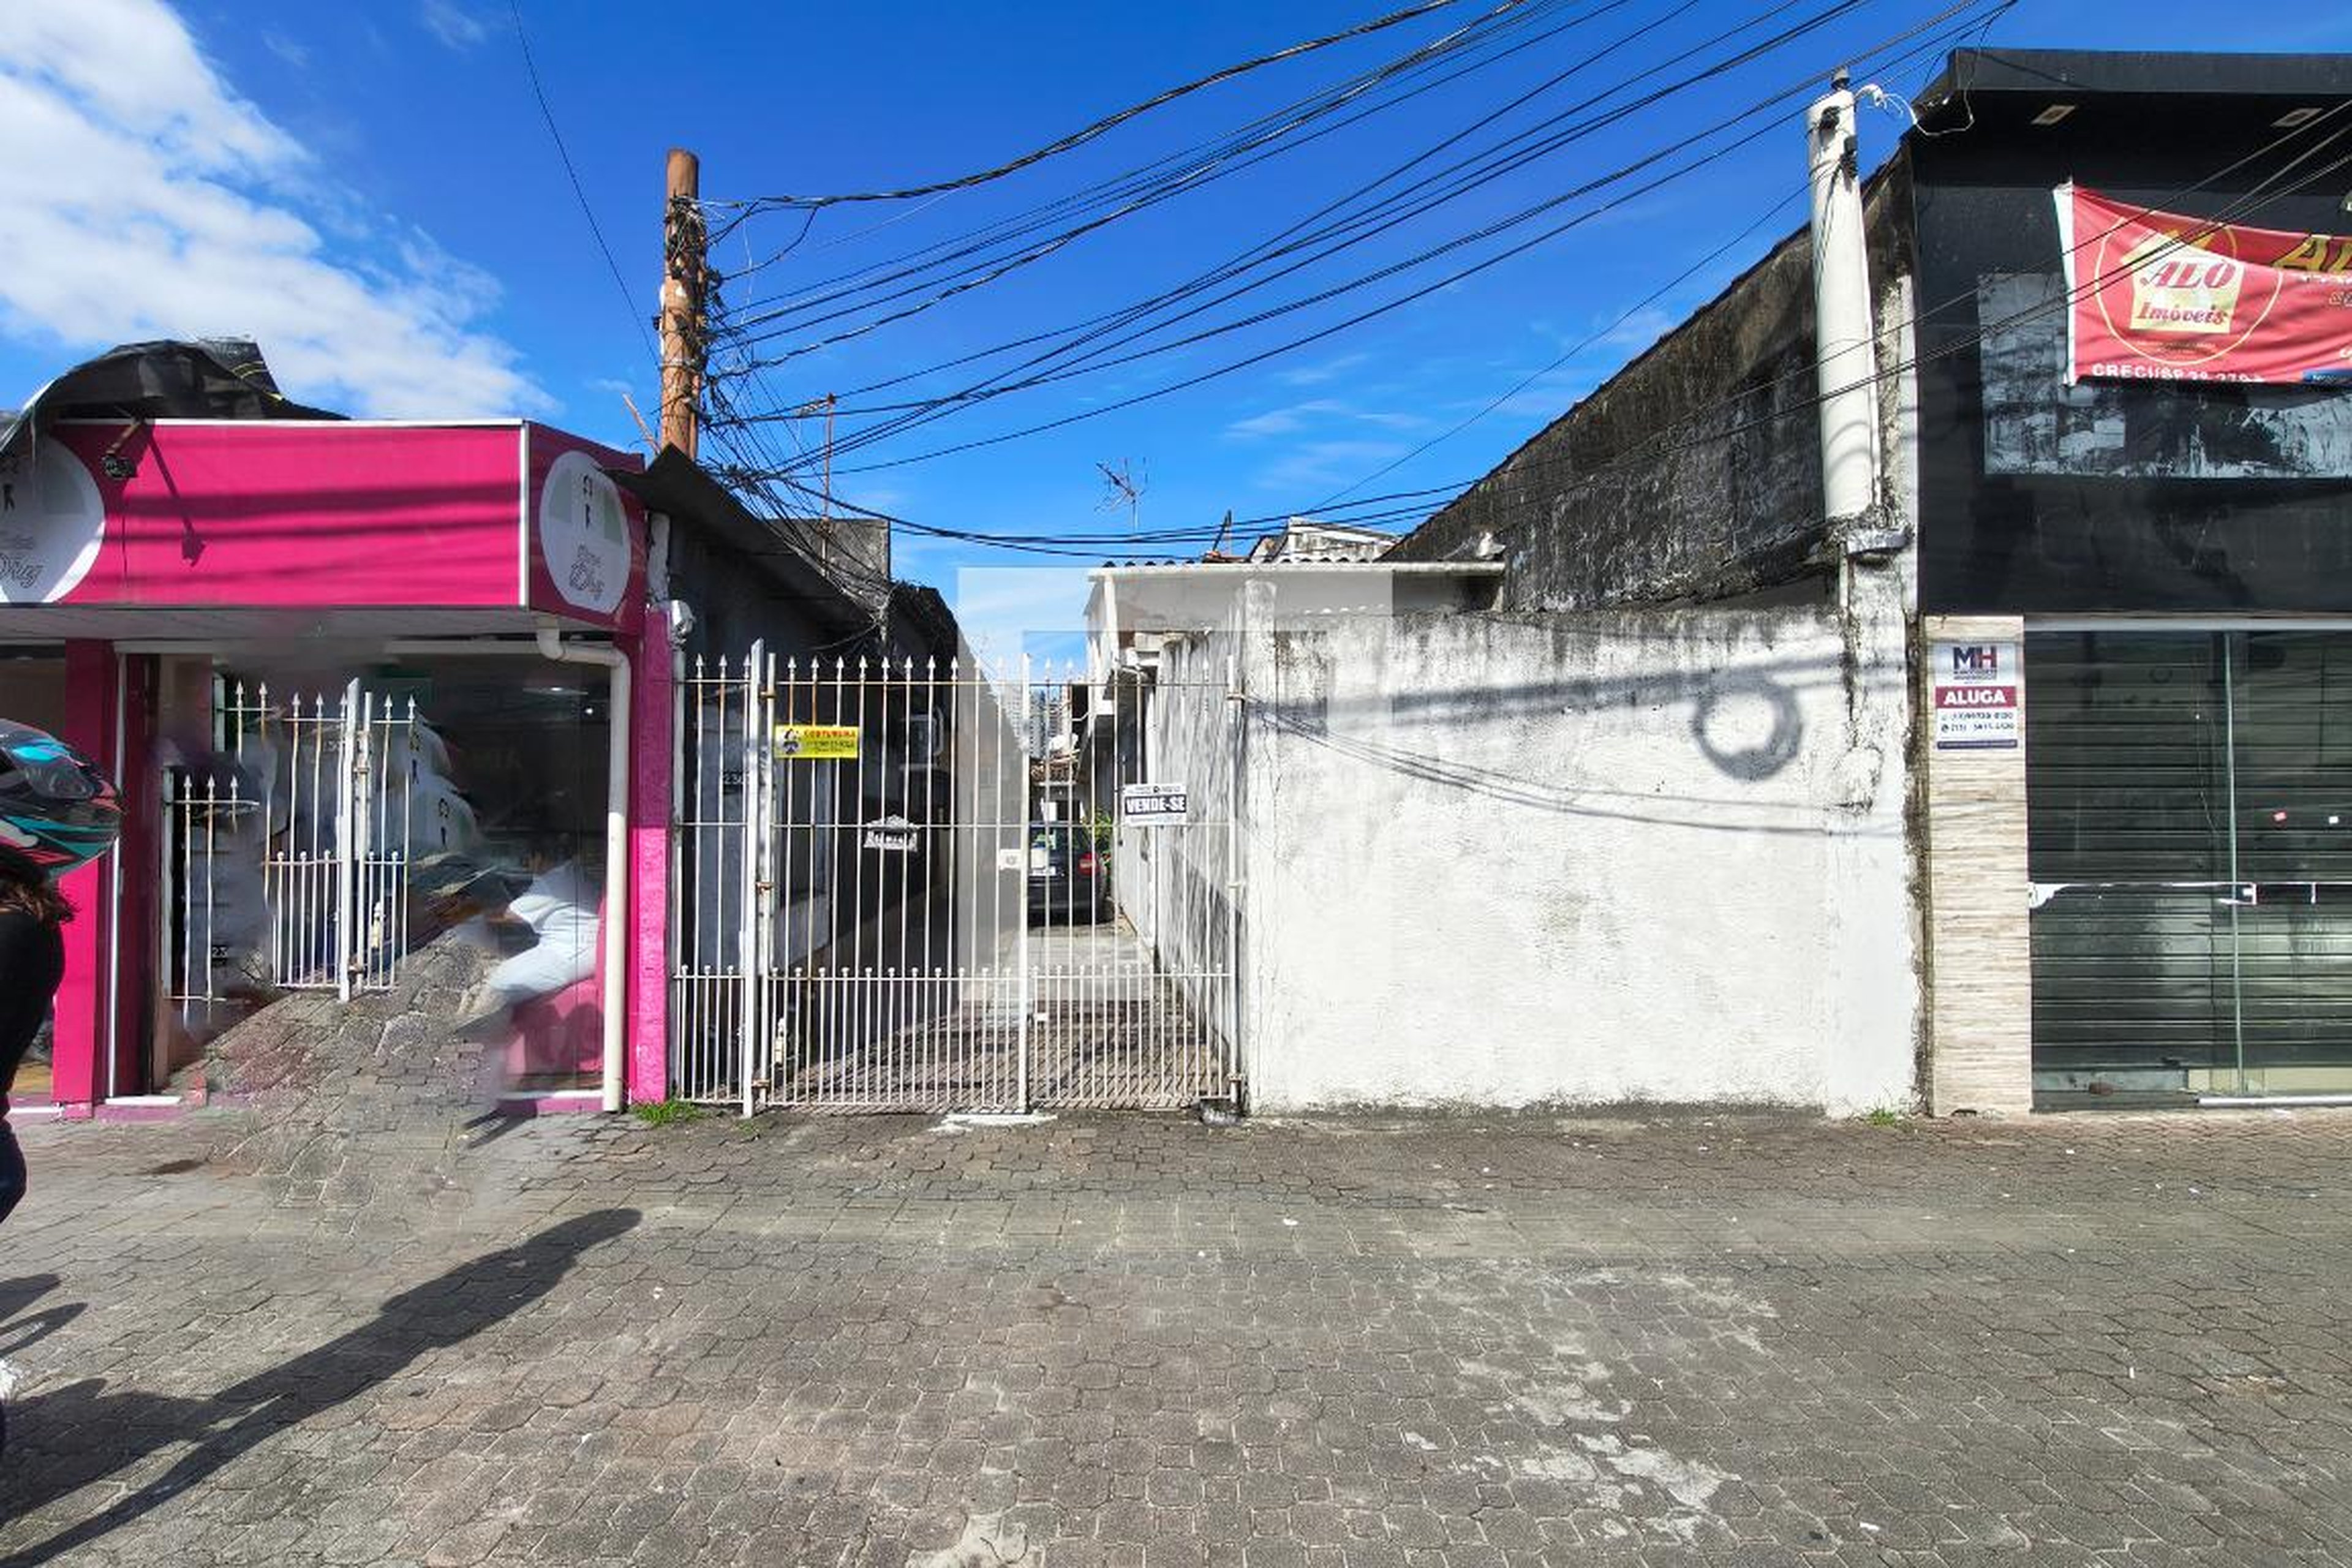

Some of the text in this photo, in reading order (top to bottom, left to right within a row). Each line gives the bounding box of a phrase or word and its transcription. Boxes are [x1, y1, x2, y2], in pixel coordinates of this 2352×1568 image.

[1953, 646, 1997, 669] MH
[1943, 689, 2007, 705] ALUGA
[1127, 796, 1185, 813] VENDE-SE
